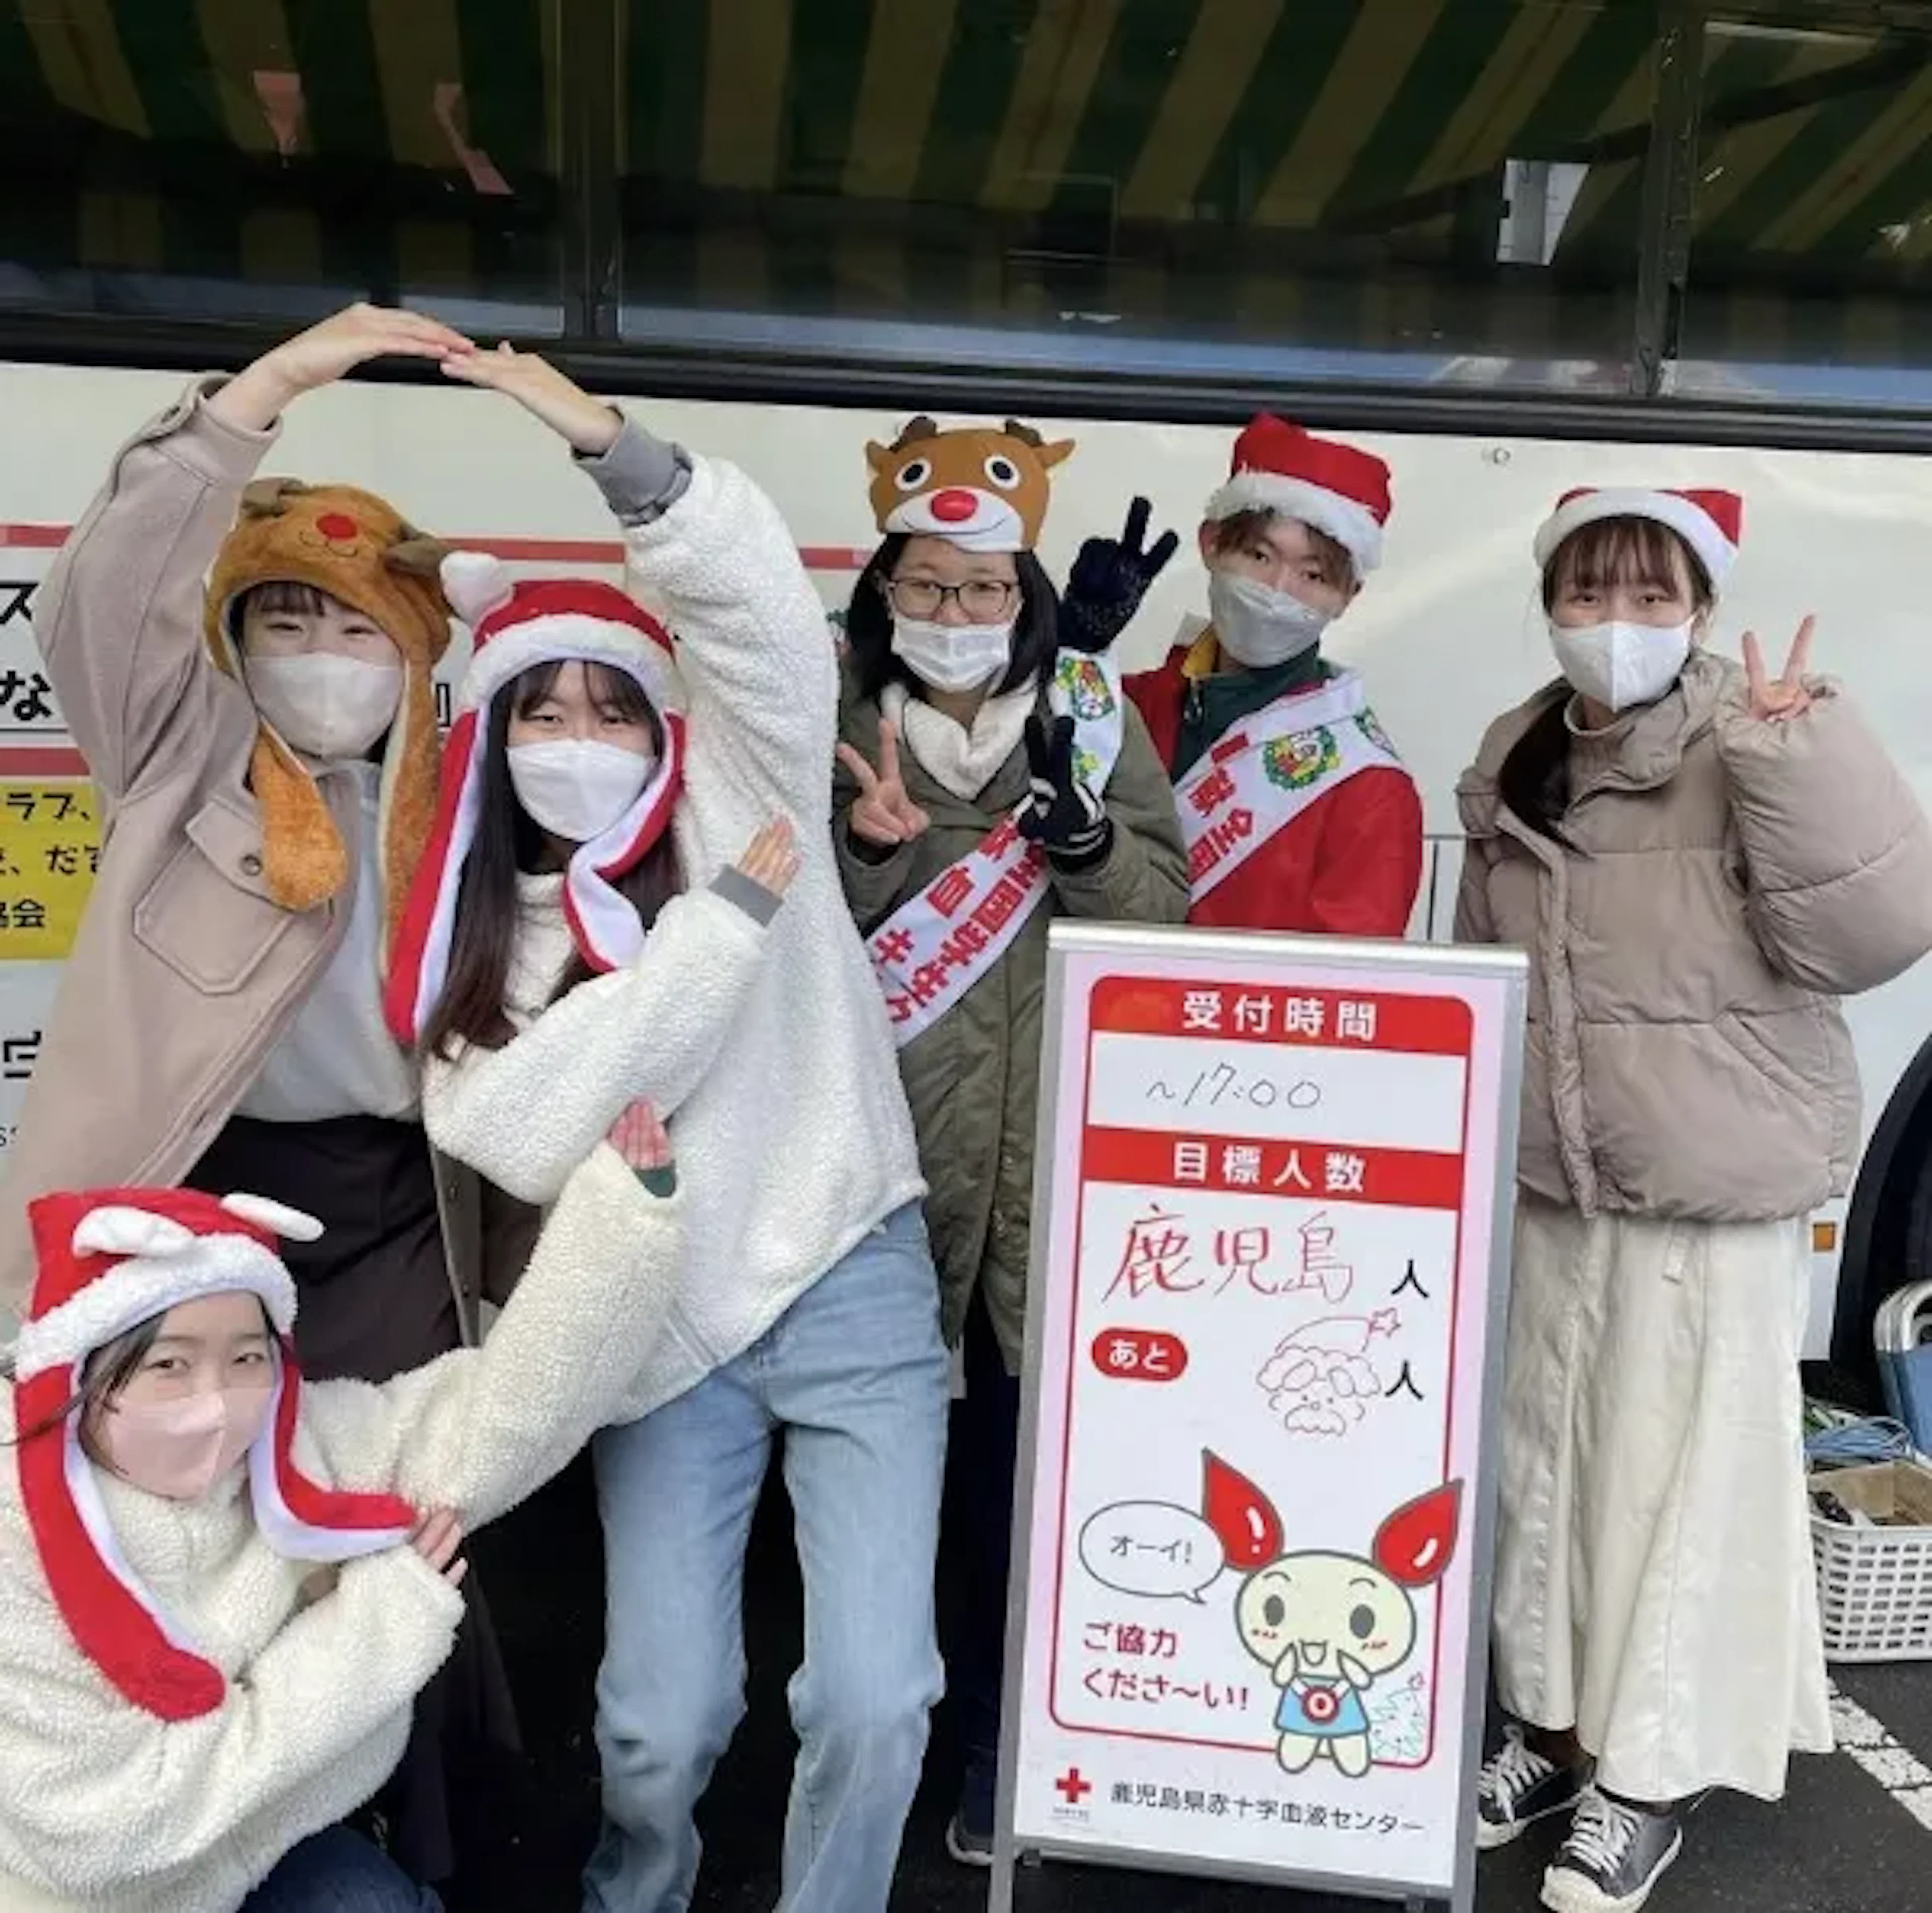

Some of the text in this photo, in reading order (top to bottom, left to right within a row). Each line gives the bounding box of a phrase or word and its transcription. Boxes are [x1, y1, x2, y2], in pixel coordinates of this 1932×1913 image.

[1183, 990, 1378, 1042] 受付時間
[1173, 1141, 1366, 1193] 目標人数
[1101, 1204, 1353, 1304] 鹿児島
[1391, 1259, 1430, 1299] 人
[1109, 1337, 1171, 1373] あと
[1385, 1361, 1424, 1400] 人
[1084, 1622, 1177, 1658] ご協力
[1110, 1782, 1425, 1833] 鹿児島県赤十字血液センター
